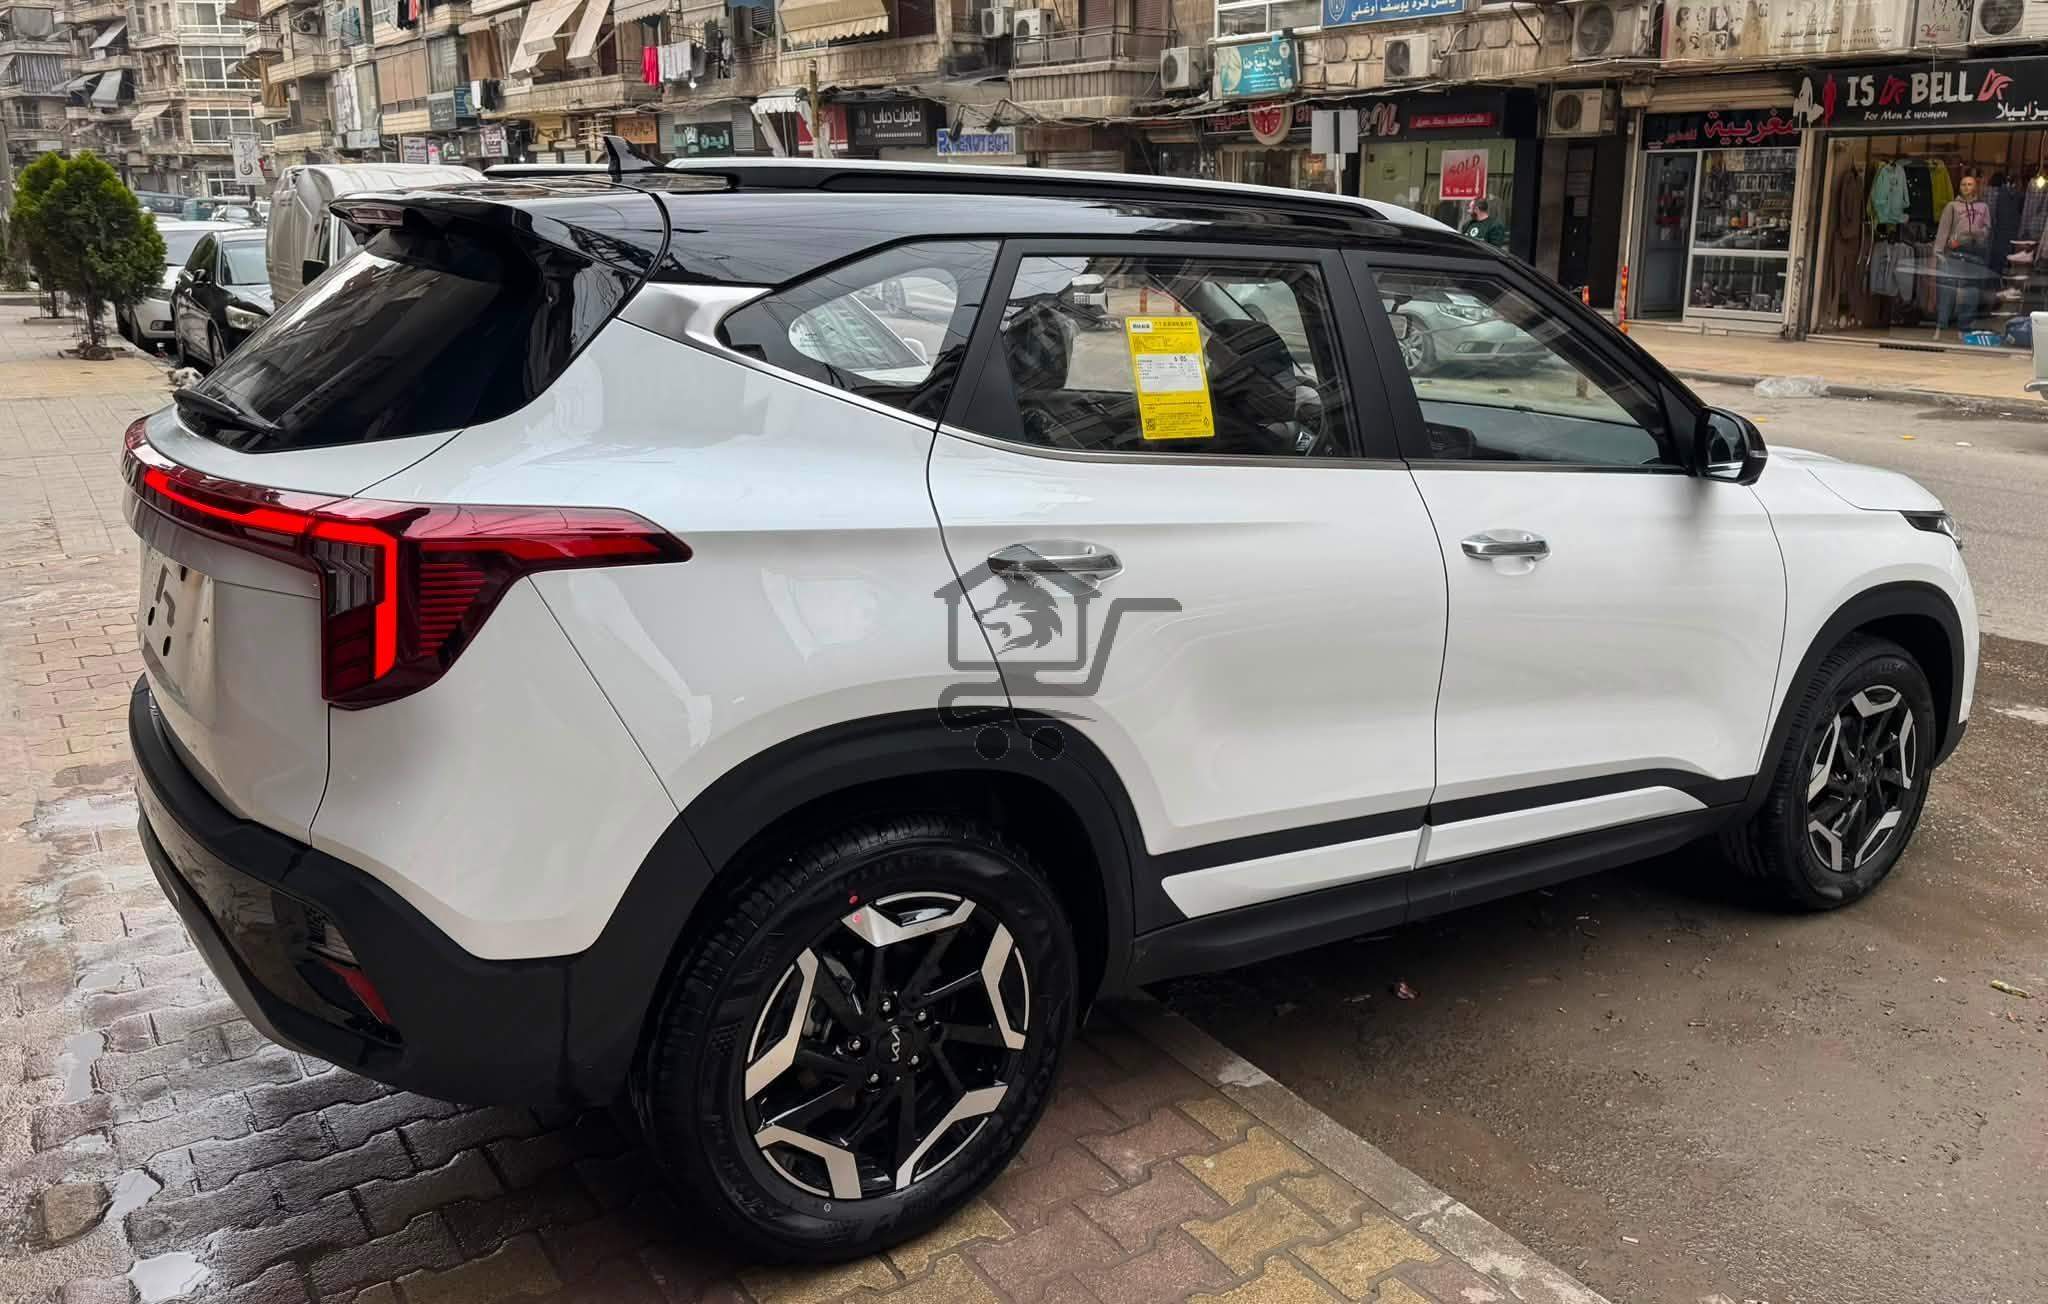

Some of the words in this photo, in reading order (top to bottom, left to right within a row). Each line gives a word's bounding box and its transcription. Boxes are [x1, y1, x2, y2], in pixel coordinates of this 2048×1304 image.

[1910, 71, 1974, 105] BELL
[893, 105, 921, 127] حلويات
[1864, 111, 1878, 121] For
[1880, 110, 1902, 121] Men
[1904, 109, 1911, 120] &
[1913, 111, 1949, 120] women
